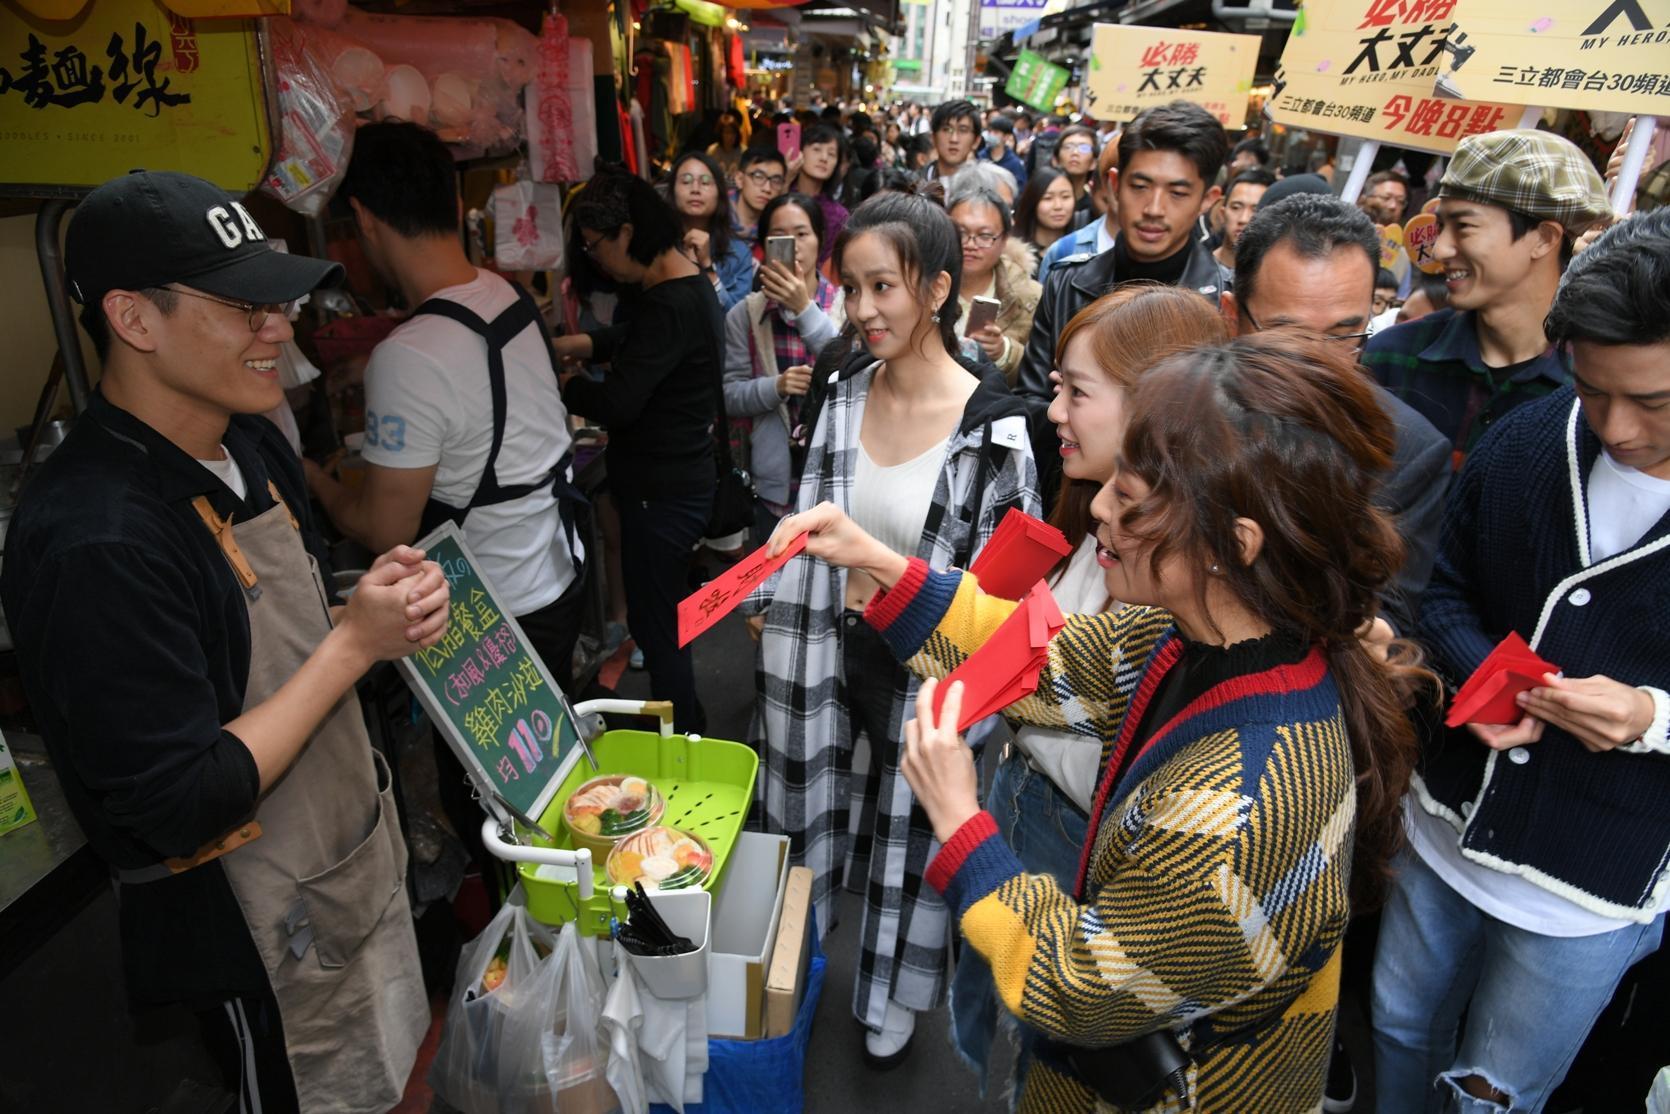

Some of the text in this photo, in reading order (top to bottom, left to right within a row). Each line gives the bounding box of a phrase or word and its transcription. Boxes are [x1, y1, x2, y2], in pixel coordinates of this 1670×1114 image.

[1138, 41, 1200, 68] 必勝
[1580, 37, 1609, 50] MY
[1137, 67, 1207, 92] 大丈夫
[1339, 77, 1355, 86] MY
[1279, 95, 1377, 124] 三立都會台30頻道
[1382, 94, 1504, 140] 今晚8點
